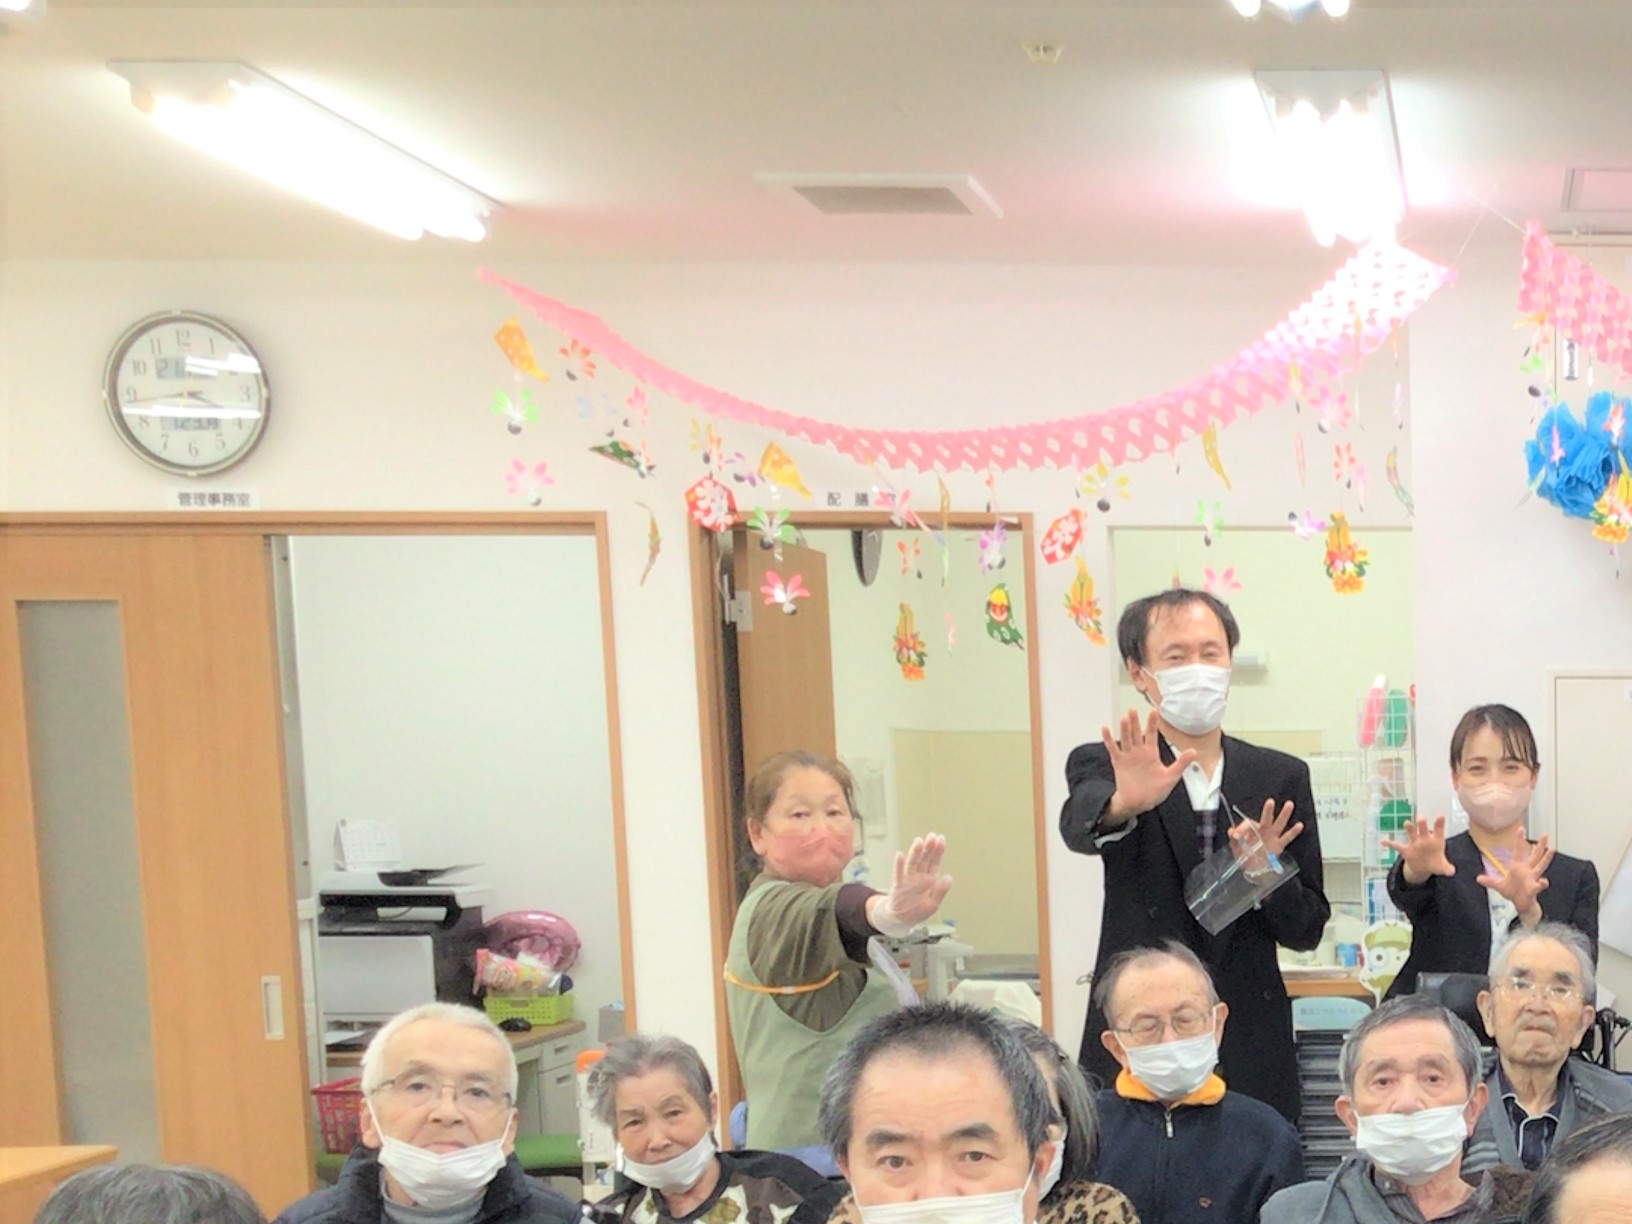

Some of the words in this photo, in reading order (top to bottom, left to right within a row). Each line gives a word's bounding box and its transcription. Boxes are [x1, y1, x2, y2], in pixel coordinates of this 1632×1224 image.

[151, 338, 162, 355] 11
[175, 329, 191, 347] 12
[209, 337, 215, 354] 1
[133, 359, 147, 376] 10
[126, 386, 137, 402] 9
[239, 386, 250, 402] 3
[161, 433, 170, 451] 7
[188, 441, 199, 458] 6
[215, 433, 226, 450] 5
[177, 491, 251, 507] 管理事務室
